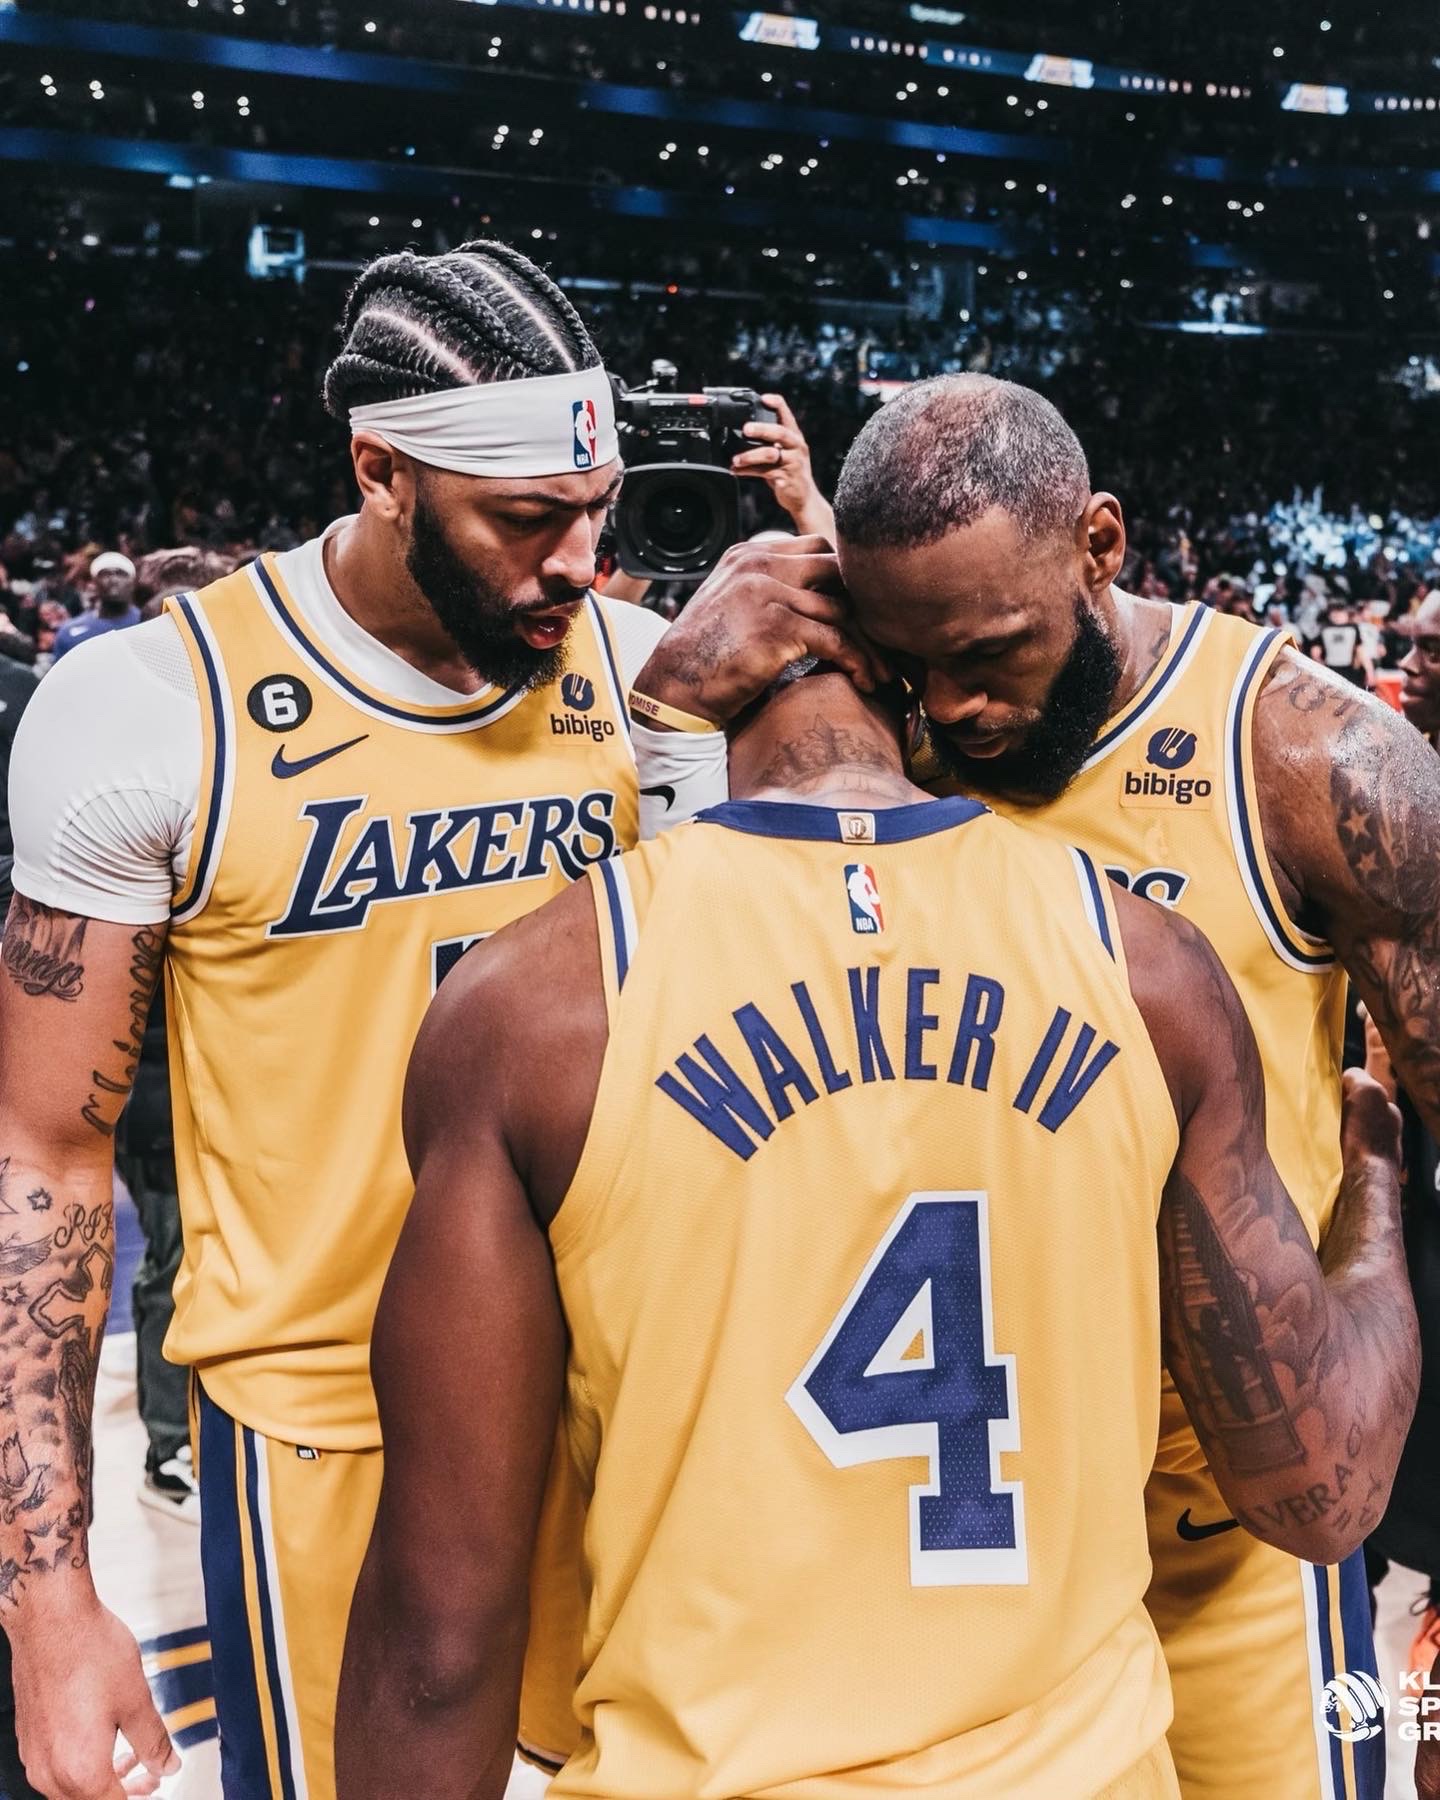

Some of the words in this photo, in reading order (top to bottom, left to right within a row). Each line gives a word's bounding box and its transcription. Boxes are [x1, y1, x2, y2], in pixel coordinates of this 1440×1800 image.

[261, 682, 299, 726] 6
[550, 713, 615, 743] bibigo
[1124, 771, 1212, 805] bibigo
[265, 789, 618, 941] LAKERS
[855, 916, 875, 931] NBA
[655, 965, 1005, 1162] WALKER
[1012, 1005, 1121, 1134] IV
[784, 1189, 1029, 1587] 4
